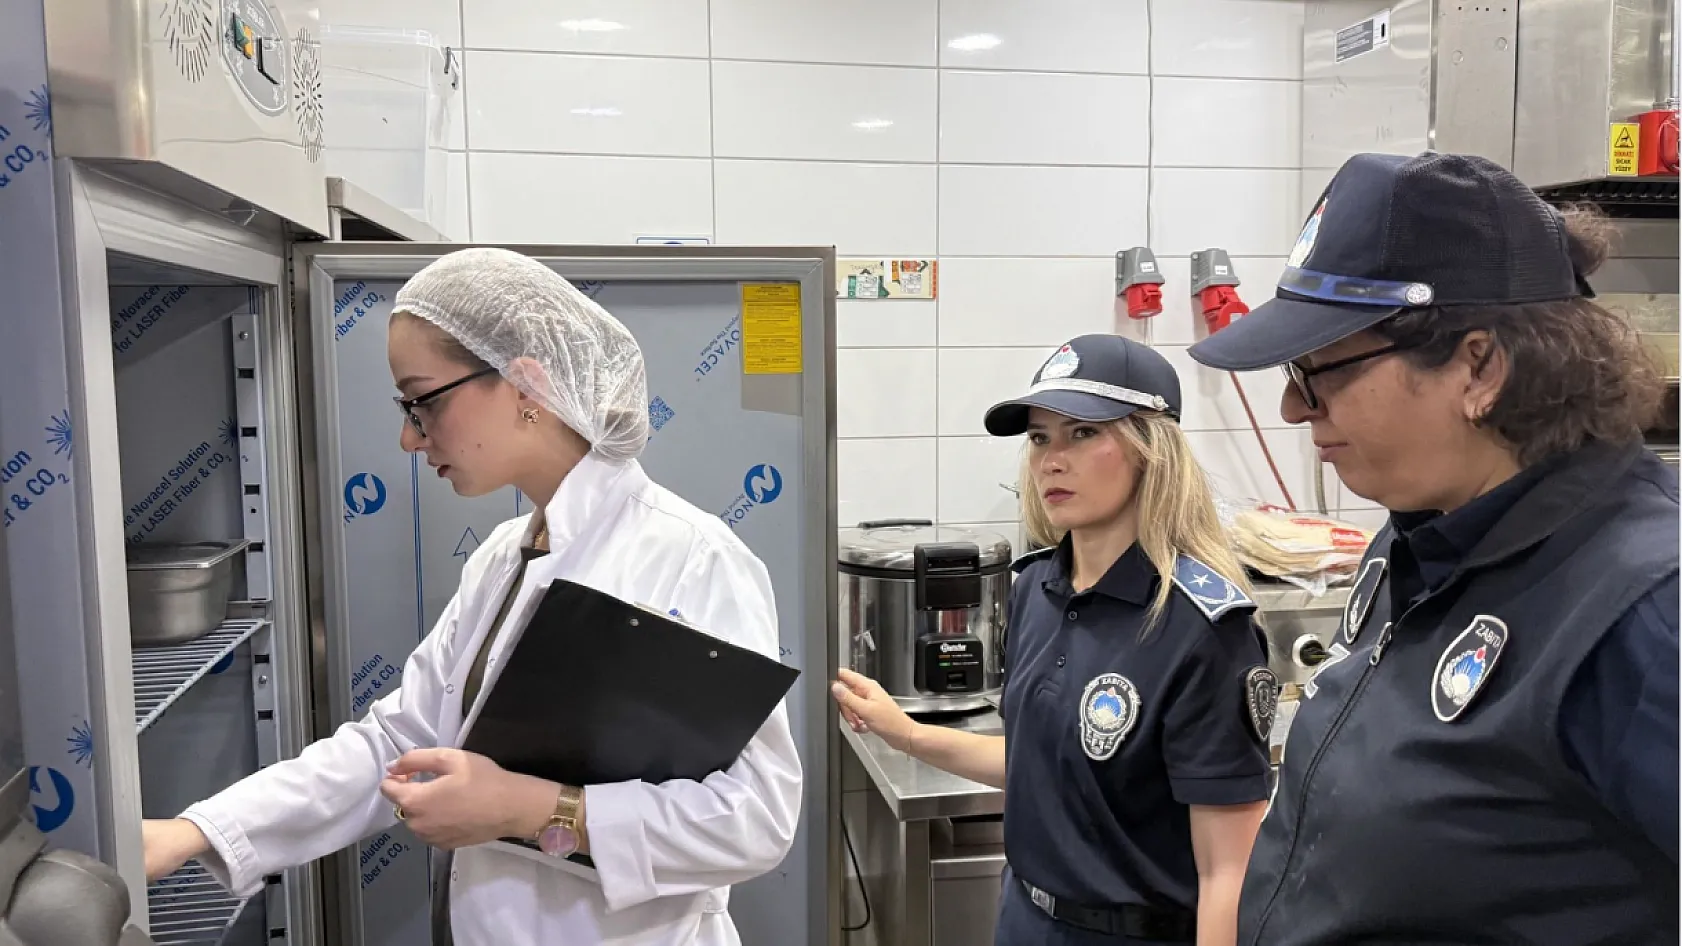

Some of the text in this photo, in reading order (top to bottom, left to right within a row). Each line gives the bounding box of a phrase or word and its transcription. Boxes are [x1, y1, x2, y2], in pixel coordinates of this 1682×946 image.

[334, 280, 367, 317] olution
[353, 307, 367, 318] &
[128, 304, 166, 339] LASER
[130, 476, 172, 517] Novacel
[167, 440, 212, 481] Solution
[11, 494, 33, 511] &
[141, 498, 178, 533] LASER
[172, 475, 201, 503] Fiber
[198, 467, 211, 479] &
[352, 654, 383, 691] olution
[371, 679, 383, 689] &
[360, 832, 392, 868] olution
